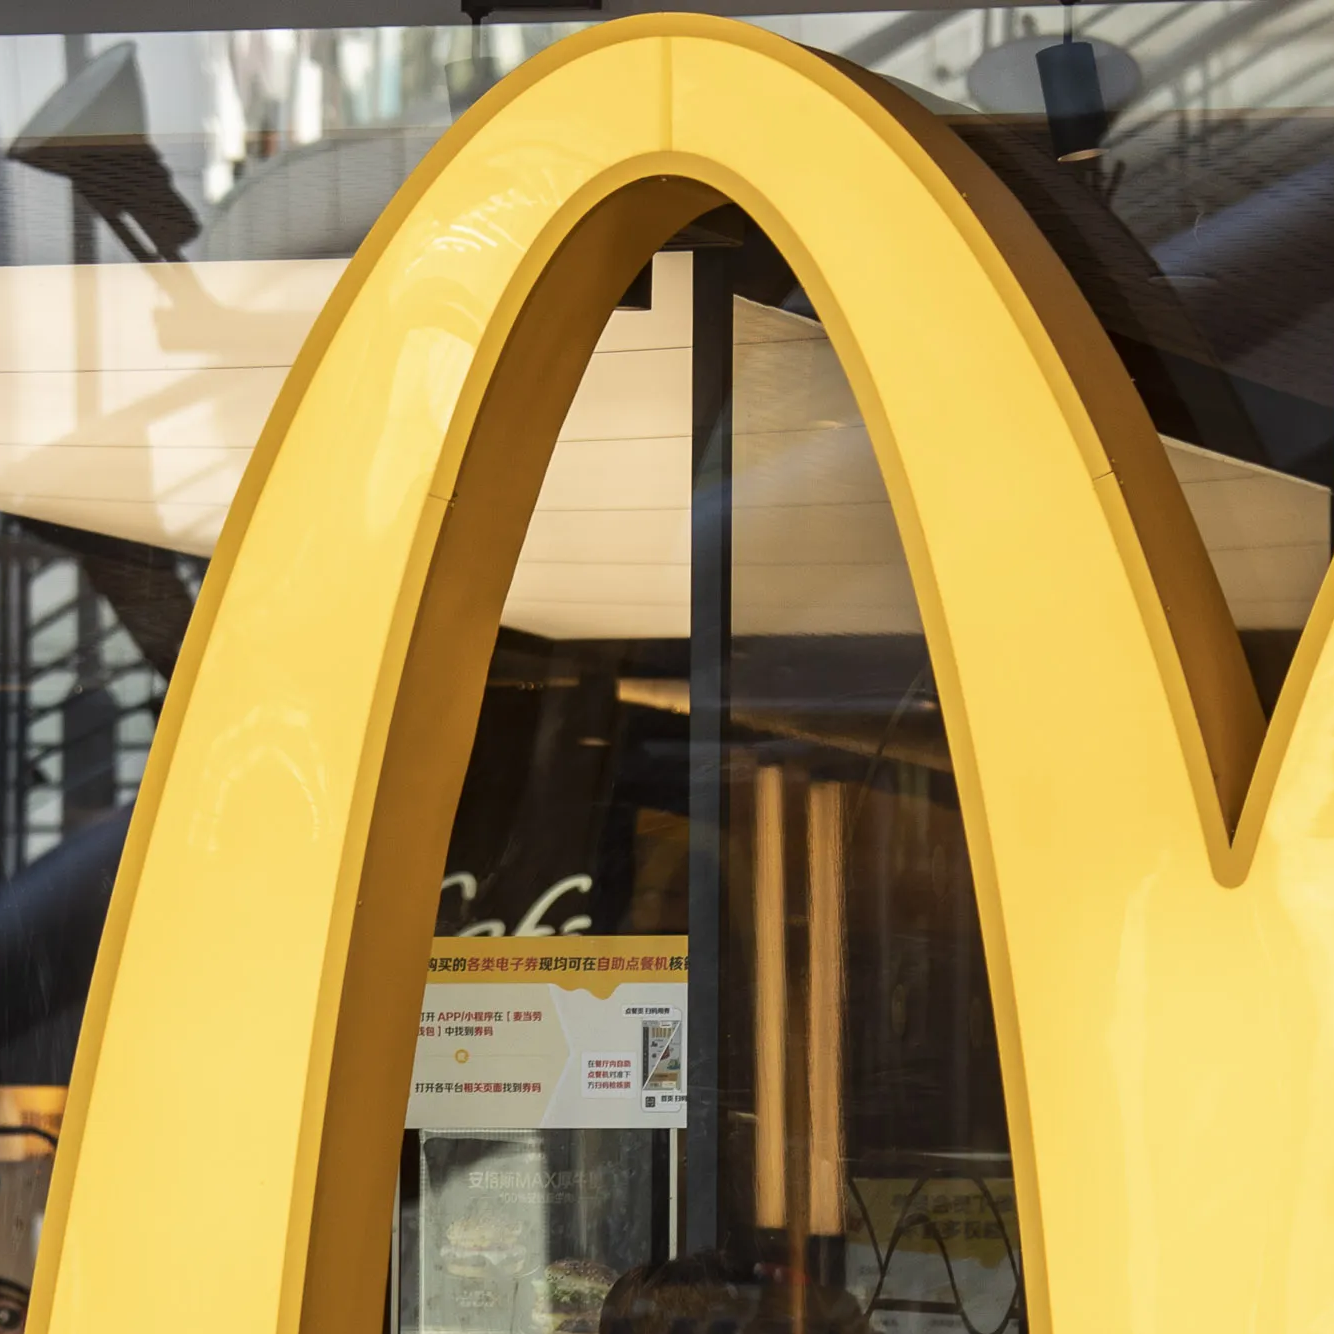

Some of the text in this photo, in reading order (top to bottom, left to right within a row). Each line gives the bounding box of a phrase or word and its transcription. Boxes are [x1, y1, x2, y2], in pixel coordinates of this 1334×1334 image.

[415, 1082, 542, 1094] 打开各平台相关页面找到券码
